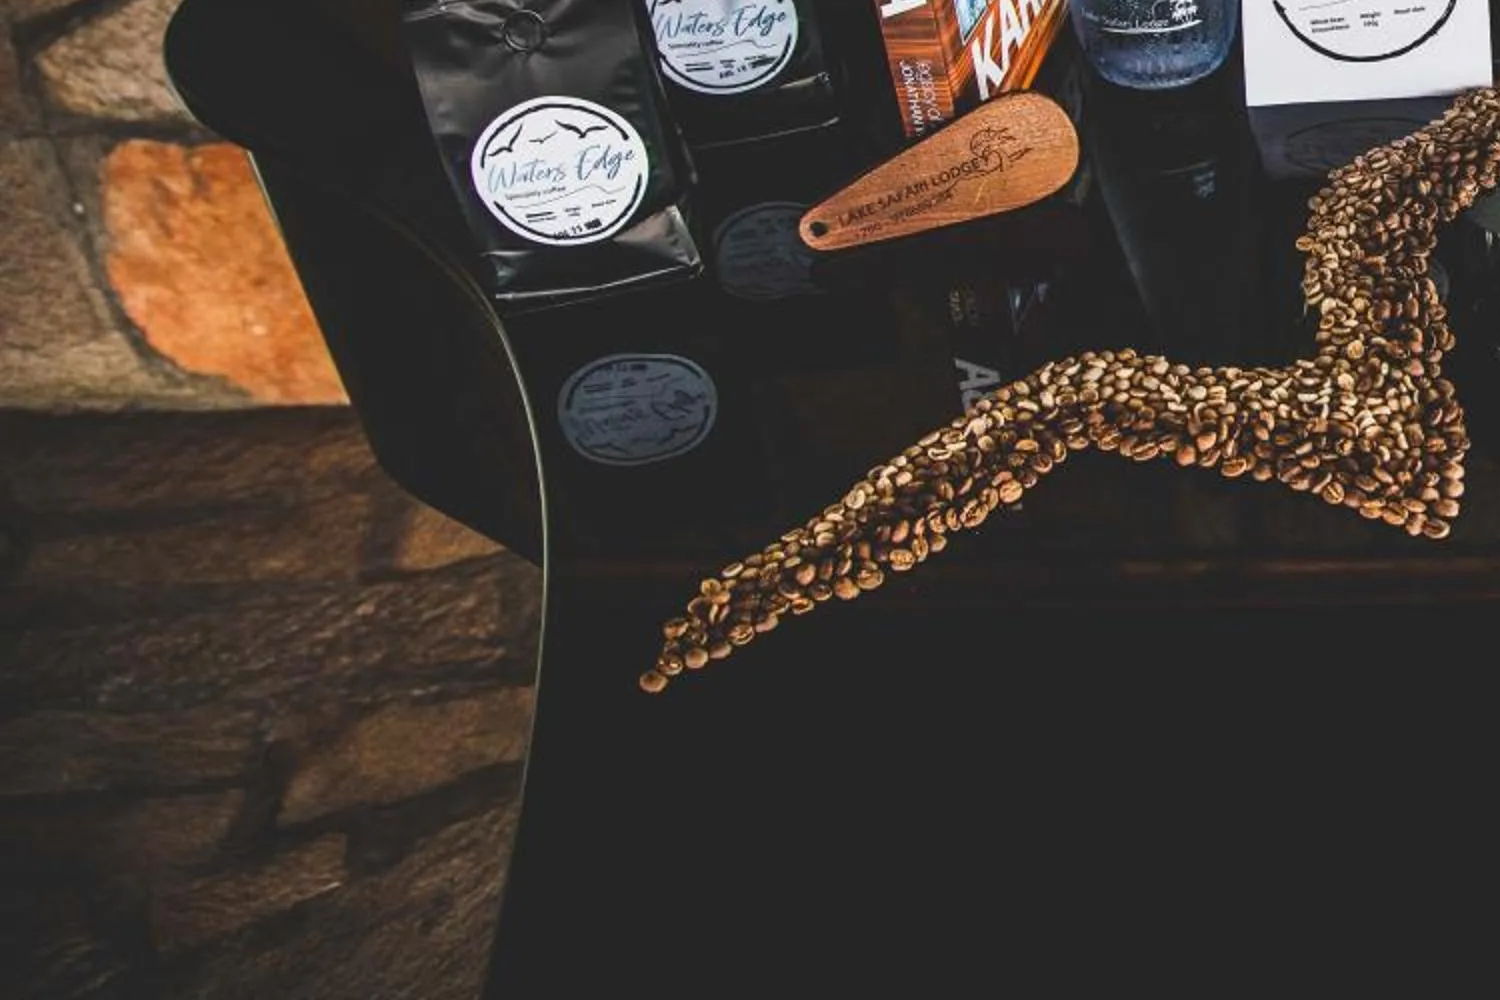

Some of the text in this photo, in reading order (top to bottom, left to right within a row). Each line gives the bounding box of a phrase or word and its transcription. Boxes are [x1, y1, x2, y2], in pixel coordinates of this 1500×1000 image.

[655, 4, 787, 43] Waters Edge
[900, 60, 925, 125] JONATHAN
[487, 143, 635, 195] Waters Edge
[840, 202, 876, 227] LAKE
[931, 157, 981, 186] LODGE
